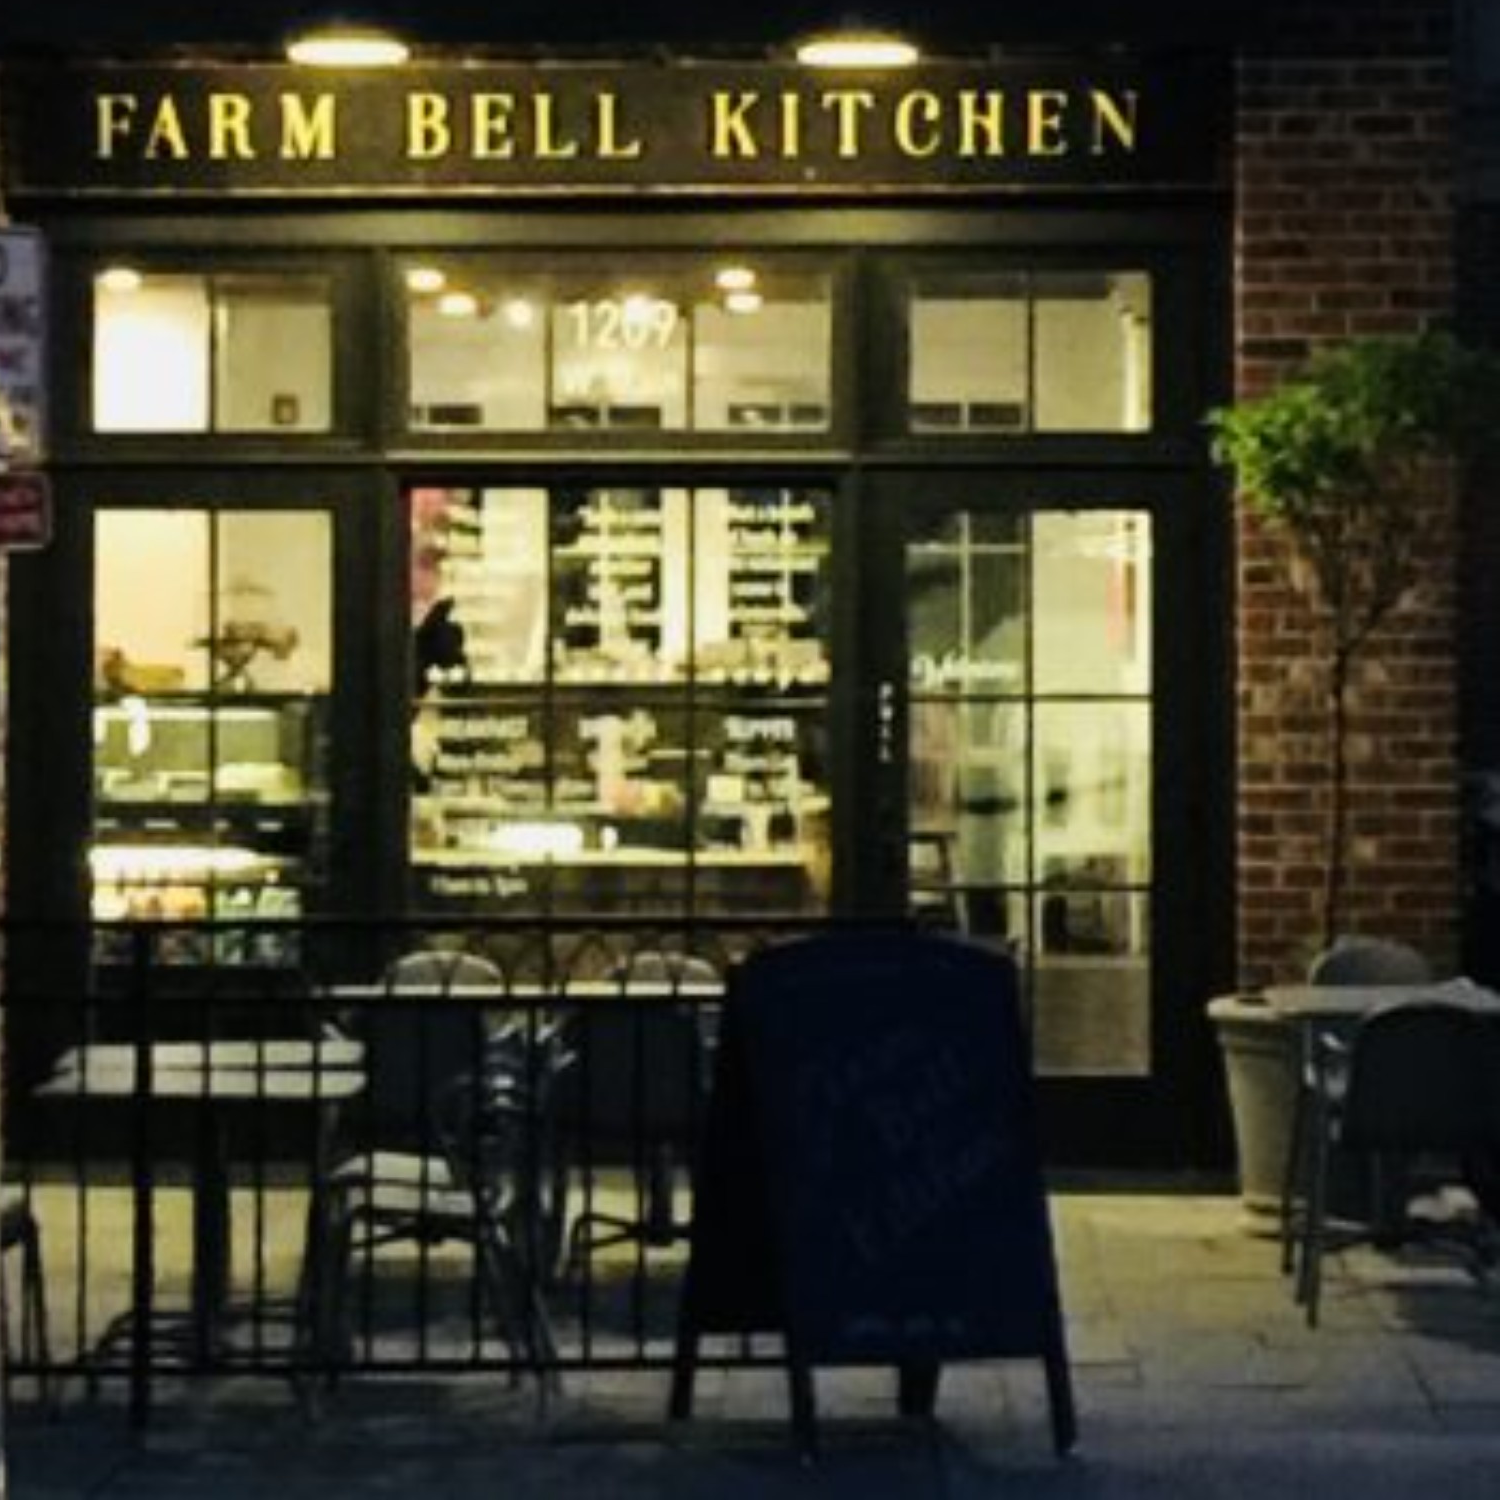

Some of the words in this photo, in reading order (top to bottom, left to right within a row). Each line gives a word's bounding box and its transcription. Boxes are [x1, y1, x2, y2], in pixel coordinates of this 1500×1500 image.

[96, 91, 339, 161] FARM
[405, 91, 642, 160] BELL
[711, 88, 1140, 159] KITCHEN
[567, 301, 678, 351] 1209
